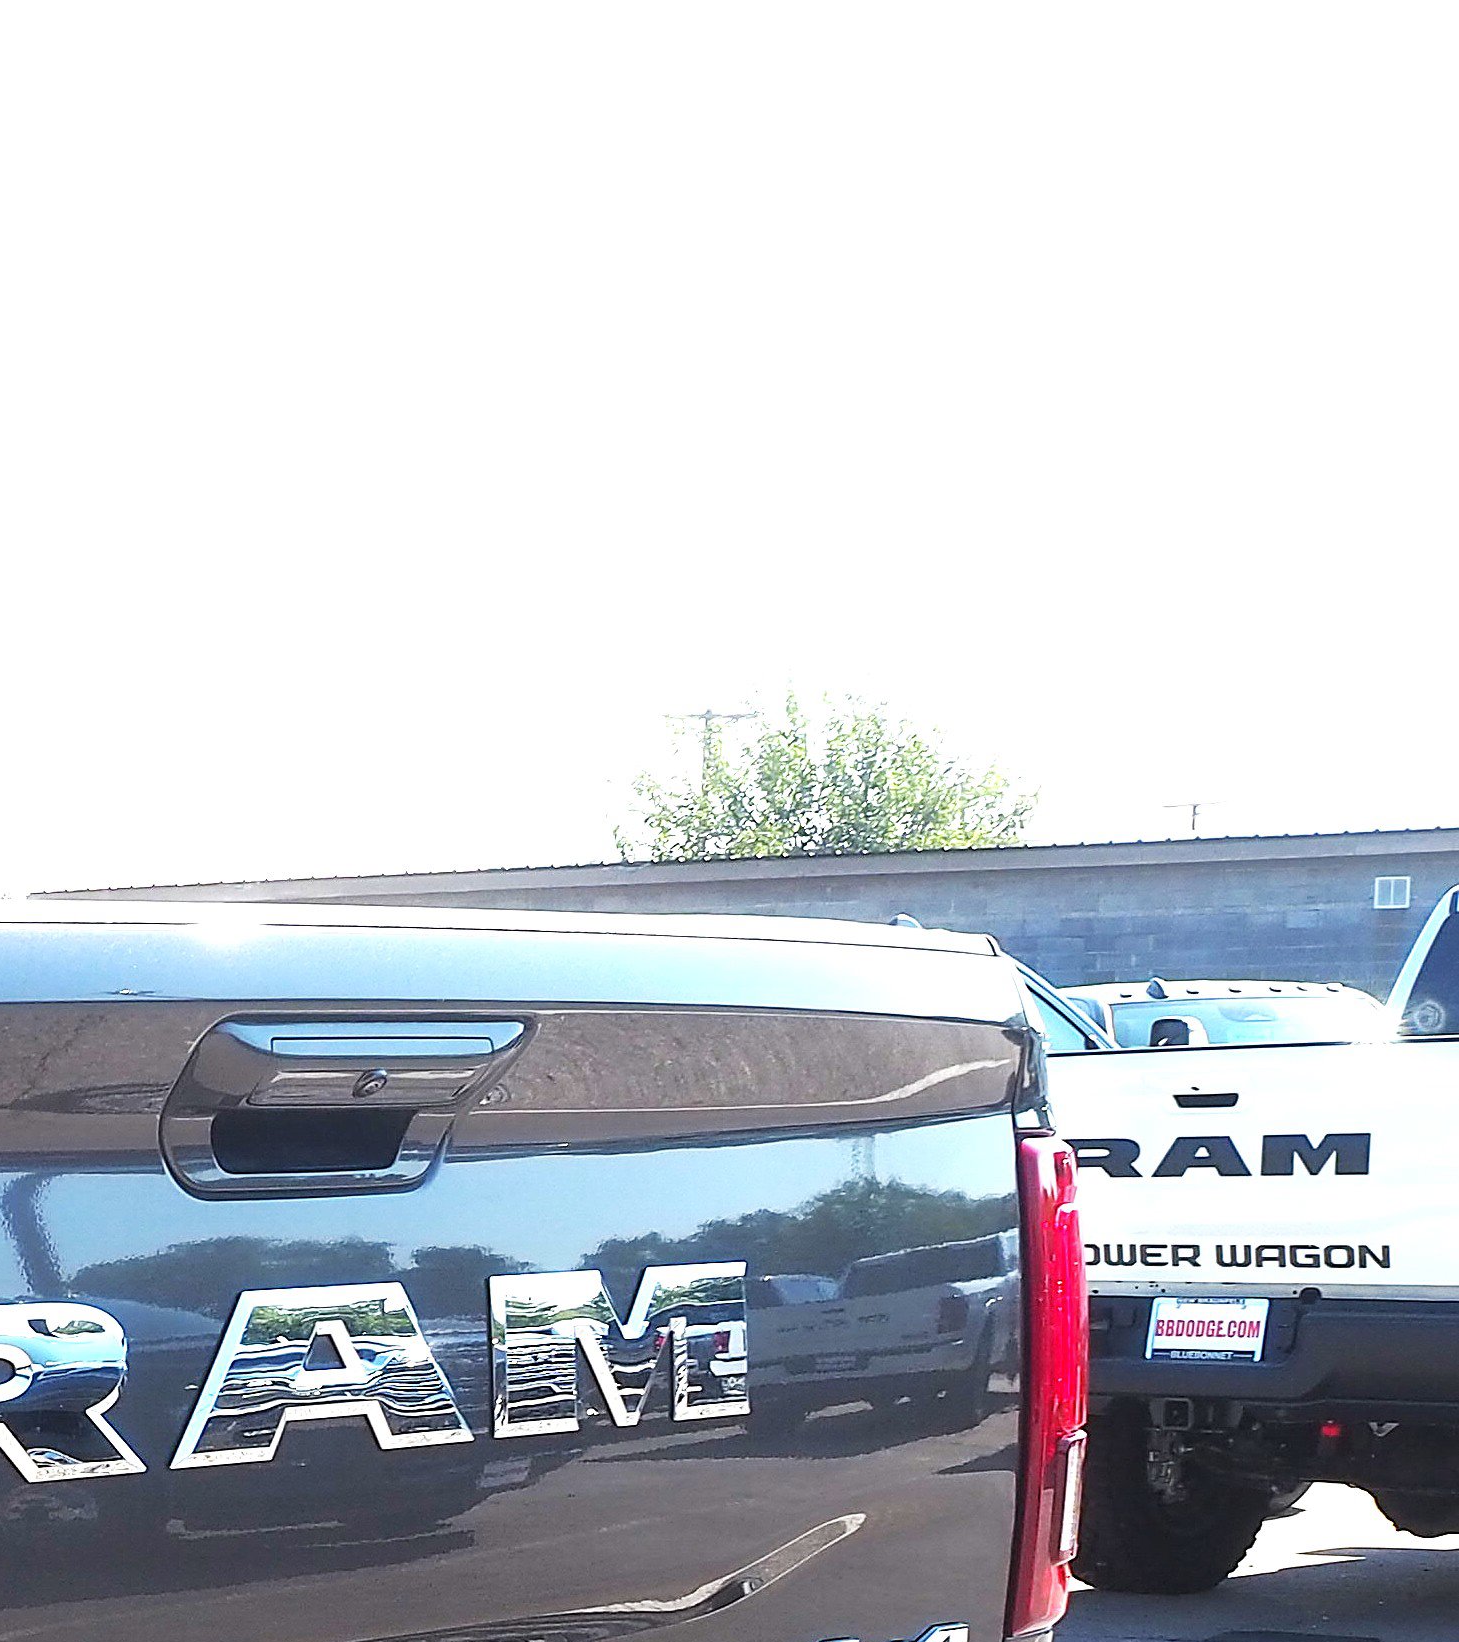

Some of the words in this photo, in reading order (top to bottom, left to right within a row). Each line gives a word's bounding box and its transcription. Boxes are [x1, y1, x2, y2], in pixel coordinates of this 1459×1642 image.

[1063, 1133, 1371, 1177] RAM
[1085, 1243, 1201, 1267] OWER
[1215, 1243, 1391, 1269] WAGON
[1155, 1319, 1261, 1338] BBDODGE.COM
